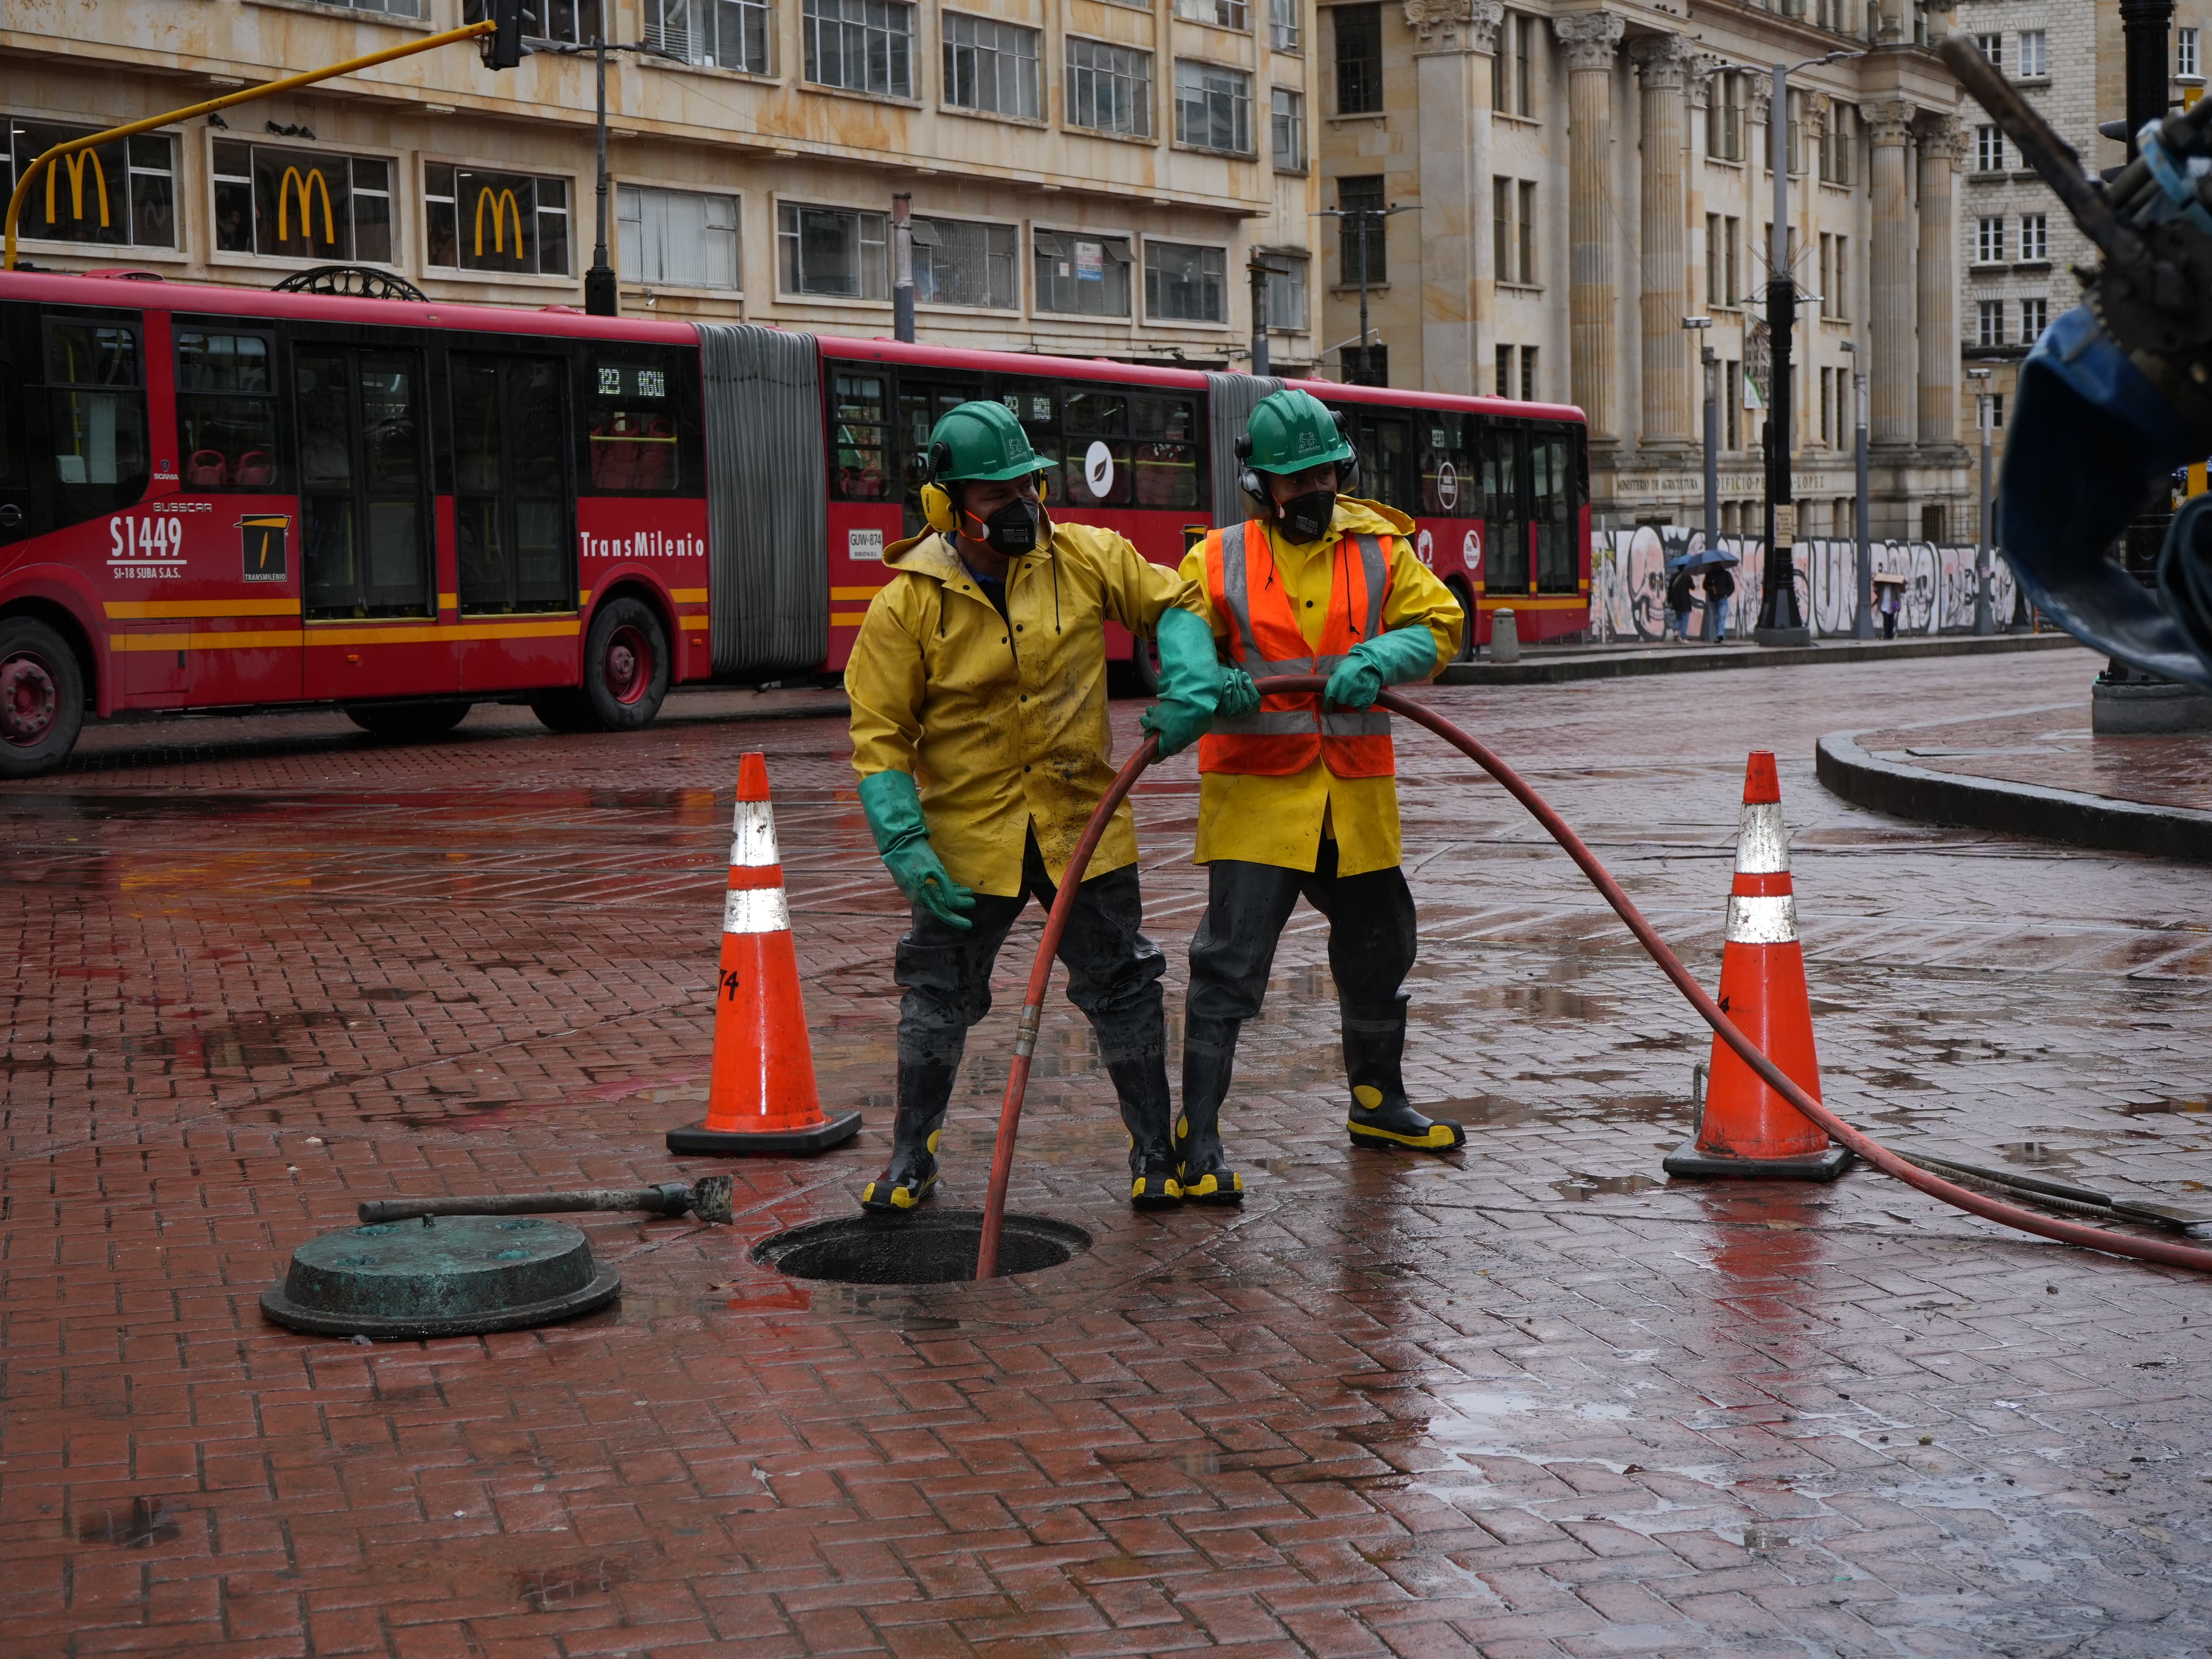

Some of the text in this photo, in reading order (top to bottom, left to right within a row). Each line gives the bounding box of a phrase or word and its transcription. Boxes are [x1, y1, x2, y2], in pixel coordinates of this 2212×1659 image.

[1617, 477, 1697, 491] MINISTERIO DE AGRICULTURA
[153, 502, 212, 512] BUSSCAR
[110, 516, 182, 557] S1449
[581, 530, 704, 557] TransMilenio
[137, 568, 157, 578] SUBA
[159, 567, 181, 578] S.A.S.
[245, 573, 286, 581] TRANSMILENIO
